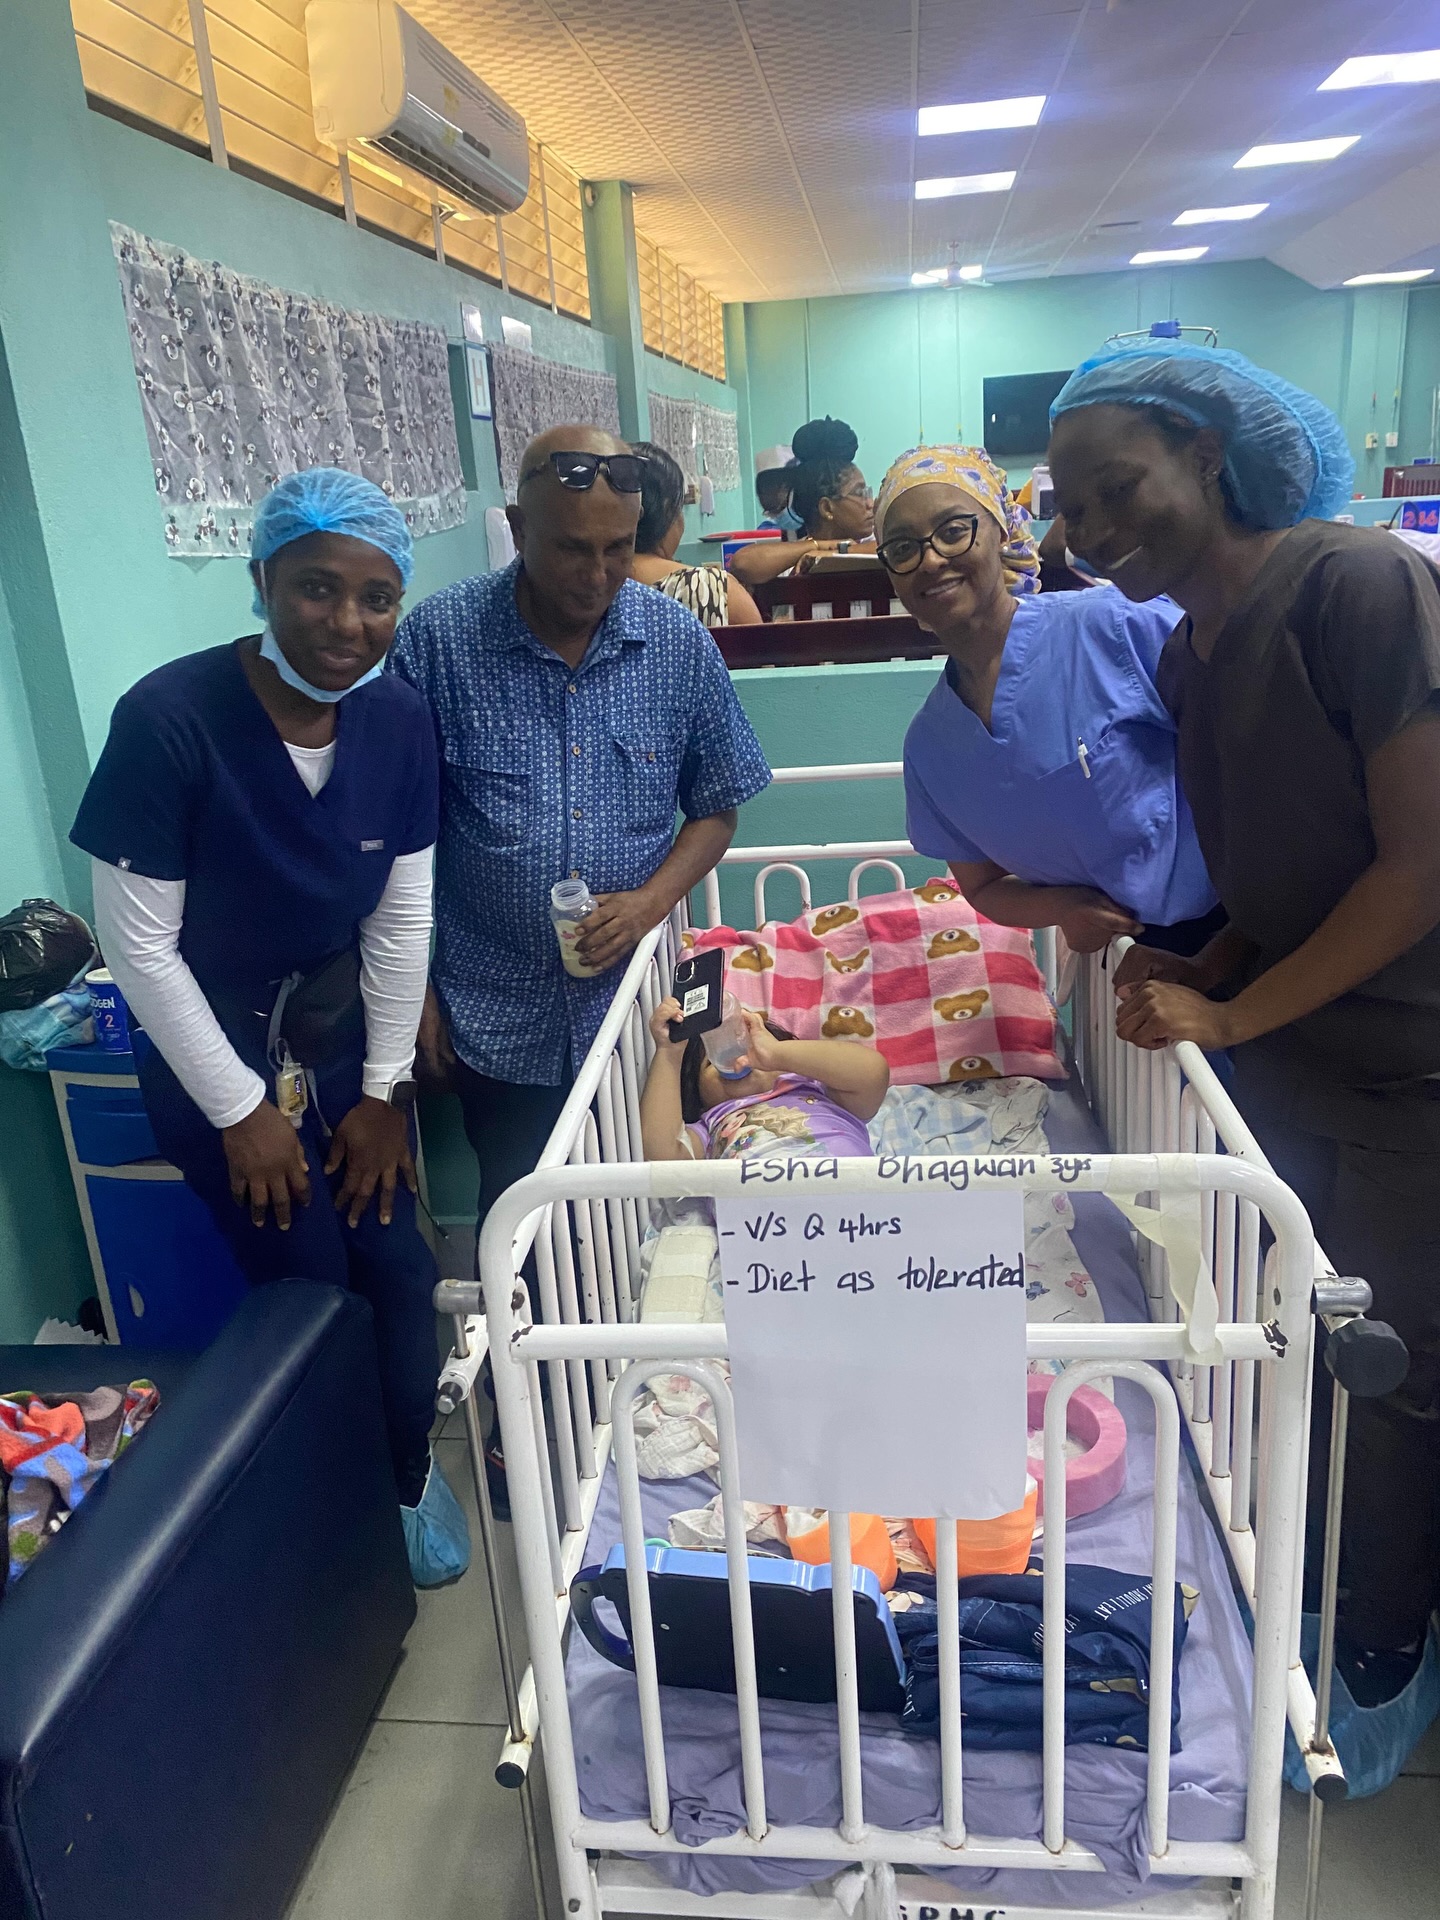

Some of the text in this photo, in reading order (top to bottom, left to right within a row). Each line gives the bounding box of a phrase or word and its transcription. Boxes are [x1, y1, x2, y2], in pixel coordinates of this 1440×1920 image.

[105, 1015, 114, 1027] 2
[741, 1158, 838, 1184] Esha
[878, 1156, 1035, 1190] Bhagwan
[803, 1213, 825, 1240] Q
[838, 1213, 901, 1243] 4hrs
[747, 1259, 816, 1294] Diet
[837, 1270, 875, 1294] as
[897, 1252, 1024, 1292] tolerated
